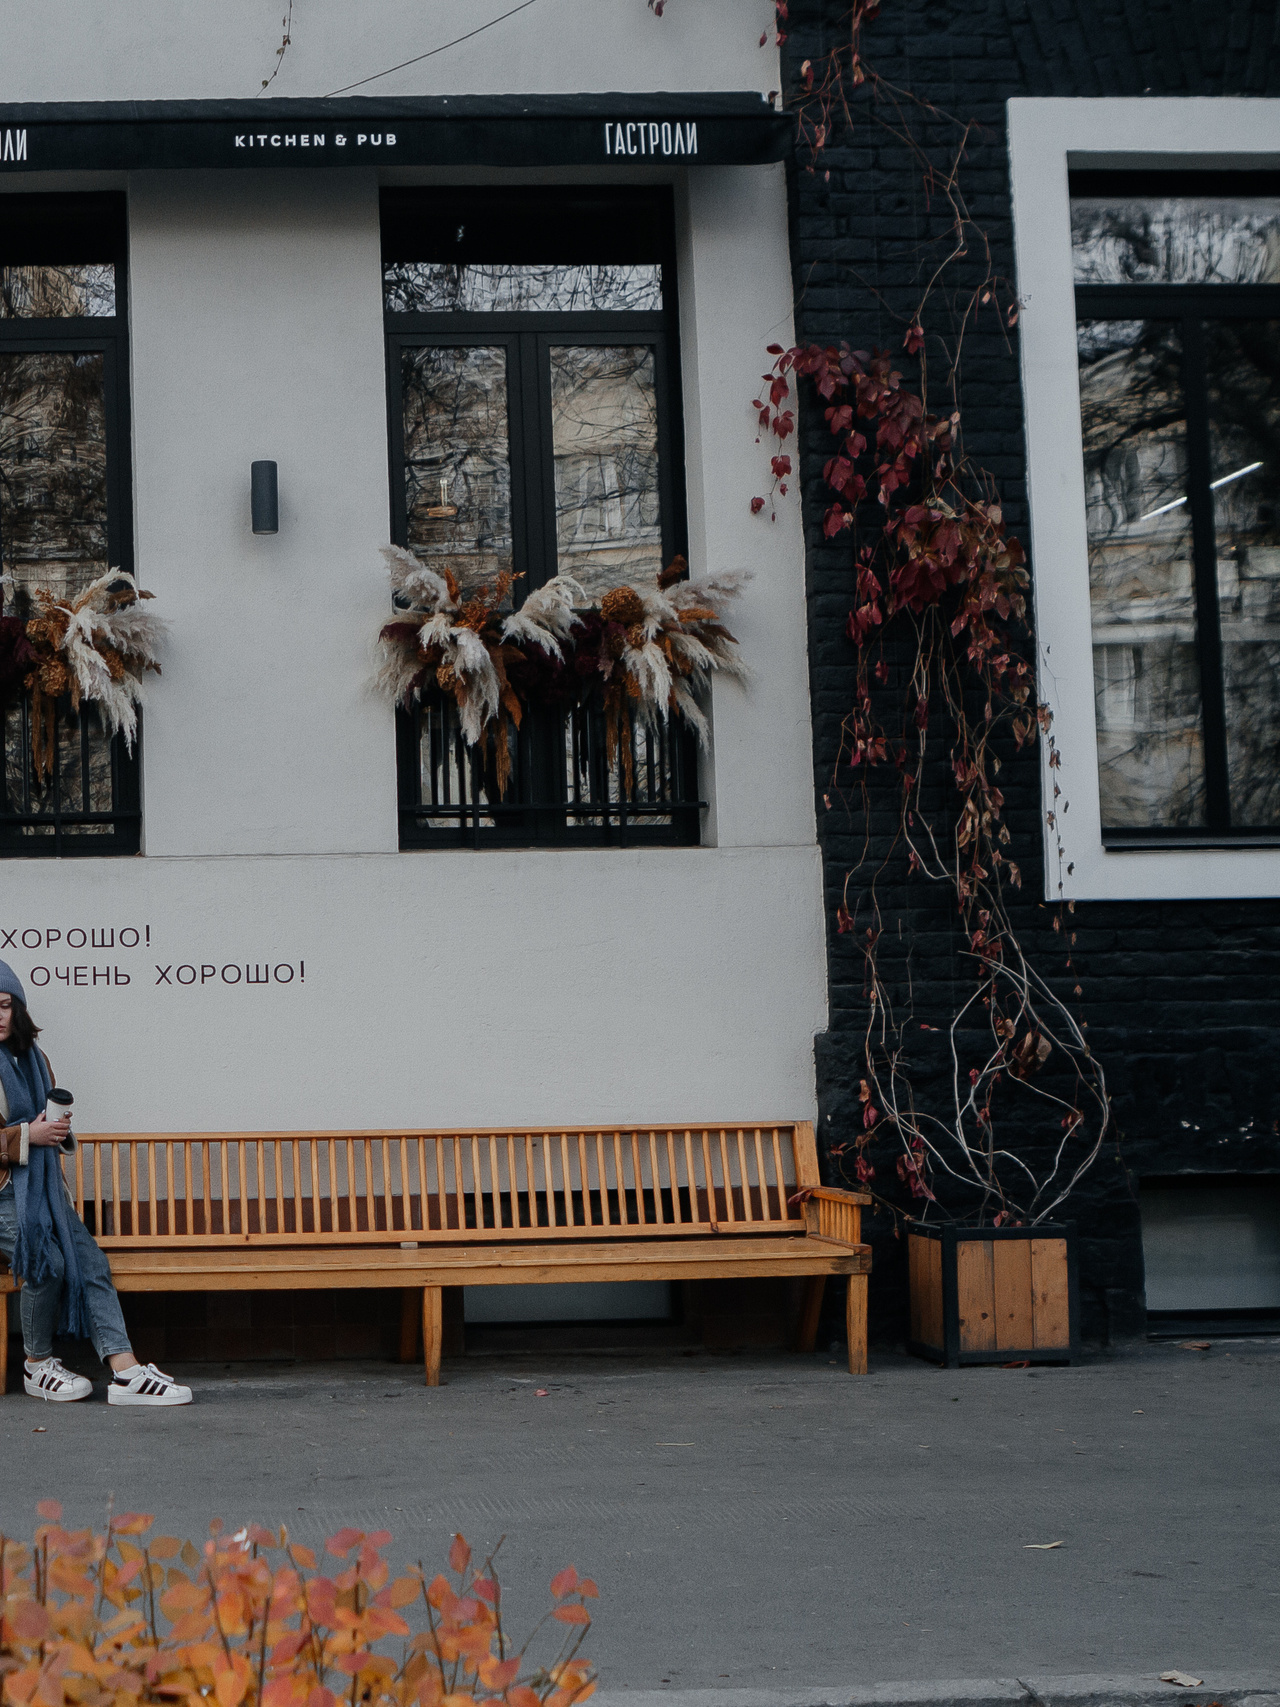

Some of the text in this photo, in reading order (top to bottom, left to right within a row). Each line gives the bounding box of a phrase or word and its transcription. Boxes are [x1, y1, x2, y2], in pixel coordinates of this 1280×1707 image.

[234, 133, 398, 148] KITCHEN & PUB
[604, 121, 698, 156] ГАСТРОЛИ
[0, 924, 151, 949] ХОРОШО!
[29, 965, 131, 987] ОЧЕНЬ
[154, 960, 305, 986] ХОРОШО!
